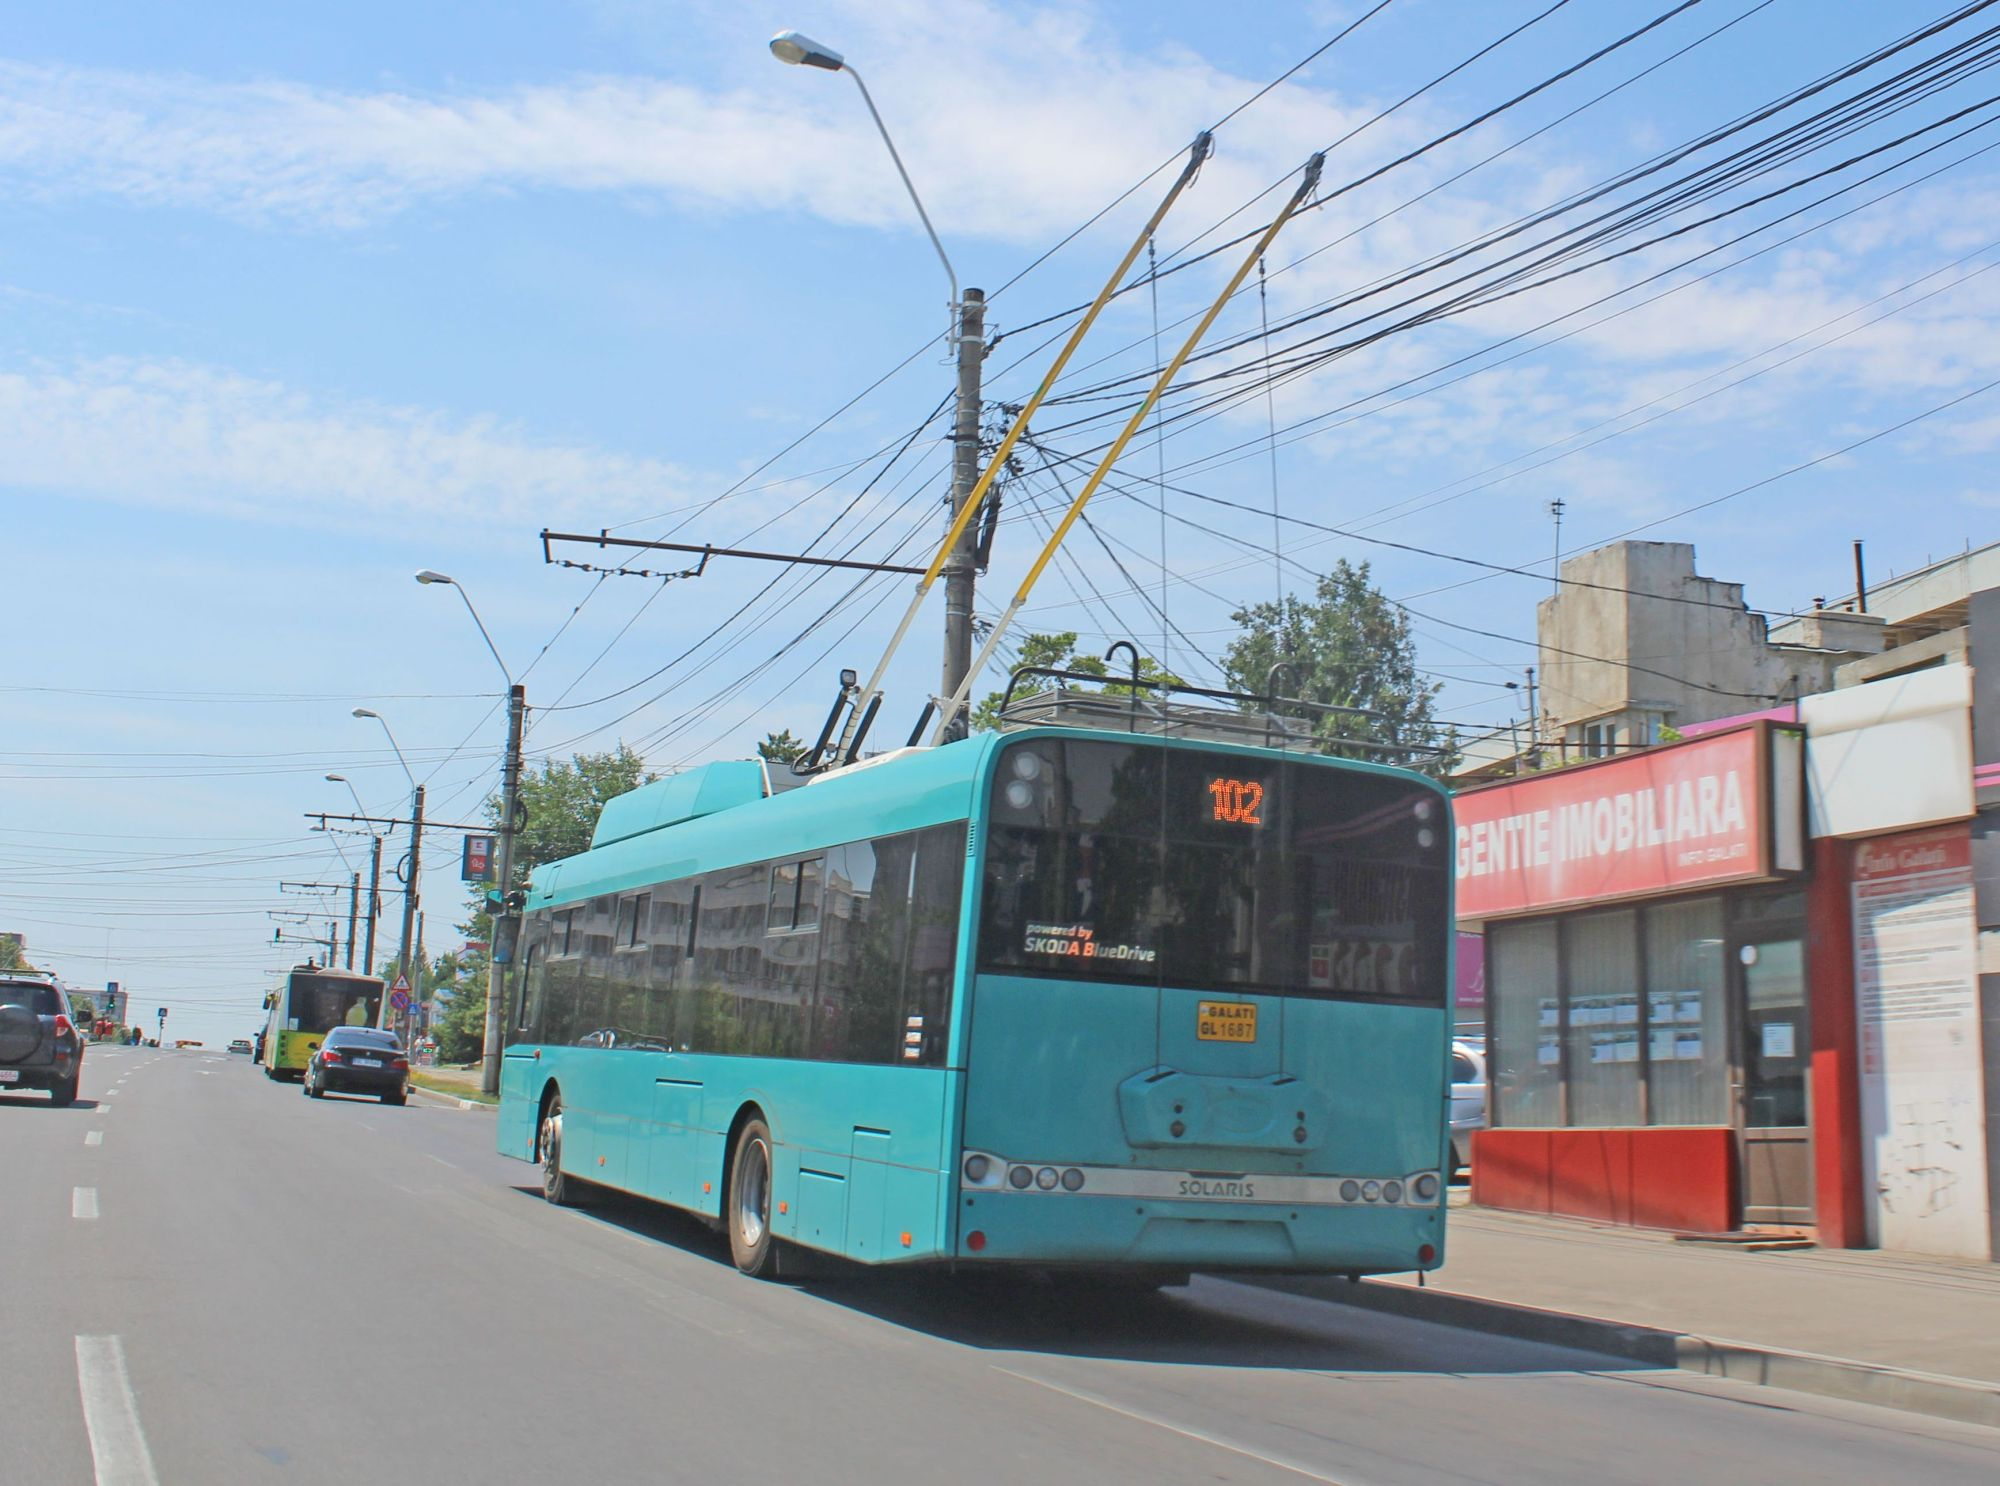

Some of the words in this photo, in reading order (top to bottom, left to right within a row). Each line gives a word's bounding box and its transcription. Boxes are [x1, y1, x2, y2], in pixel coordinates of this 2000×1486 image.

[1209, 778, 1263, 824] 102
[1557, 770, 1745, 862] IMOBILIARA
[1025, 924, 1077, 937] powered
[1078, 926, 1093, 940] by
[1024, 937, 1079, 956] SKODA
[1083, 942, 1156, 962] BlueDrive
[1208, 1006, 1255, 1020] GALATI
[1200, 1021, 1217, 1035] GL
[1220, 1022, 1253, 1038] 1687
[1179, 1180, 1255, 1198] SOLARIS
